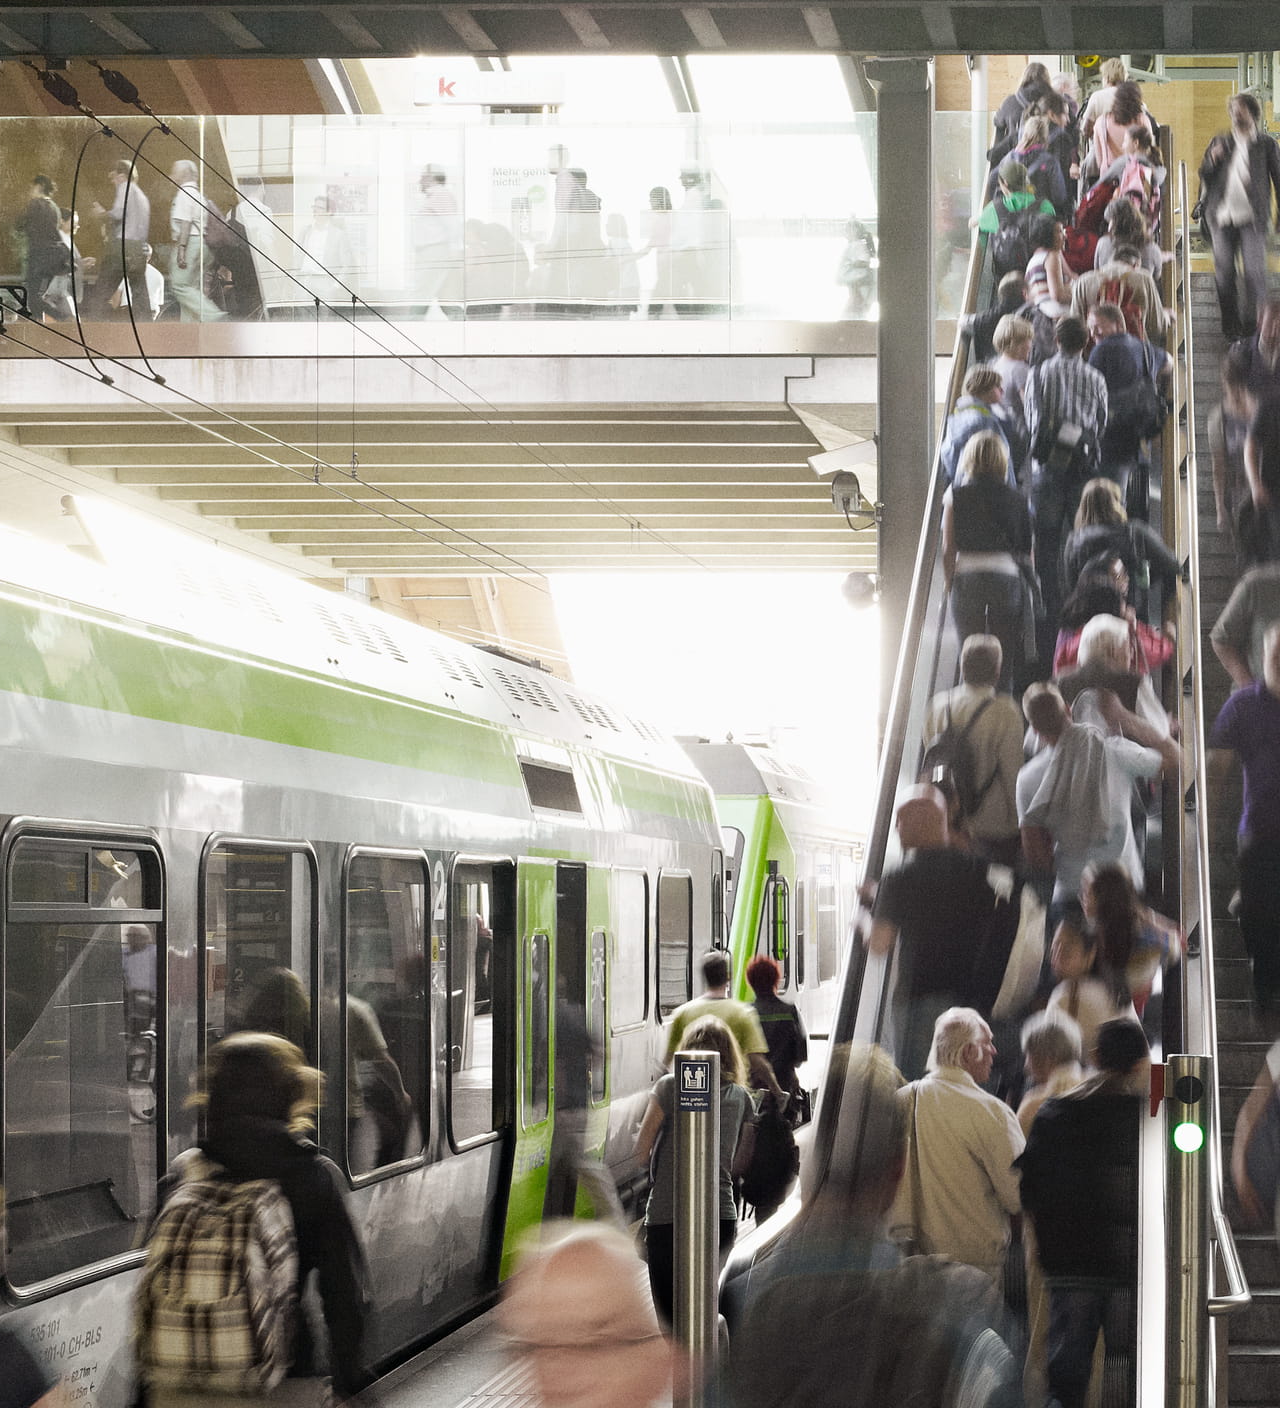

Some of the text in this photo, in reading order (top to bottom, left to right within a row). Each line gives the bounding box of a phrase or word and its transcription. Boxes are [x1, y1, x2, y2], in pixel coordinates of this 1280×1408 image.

[438, 76, 457, 98] k
[492, 168, 547, 179] Mehr geht
[433, 860, 445, 921] 2
[47, 1319, 61, 1339] 101
[68, 1326, 103, 1356] CH-BLS
